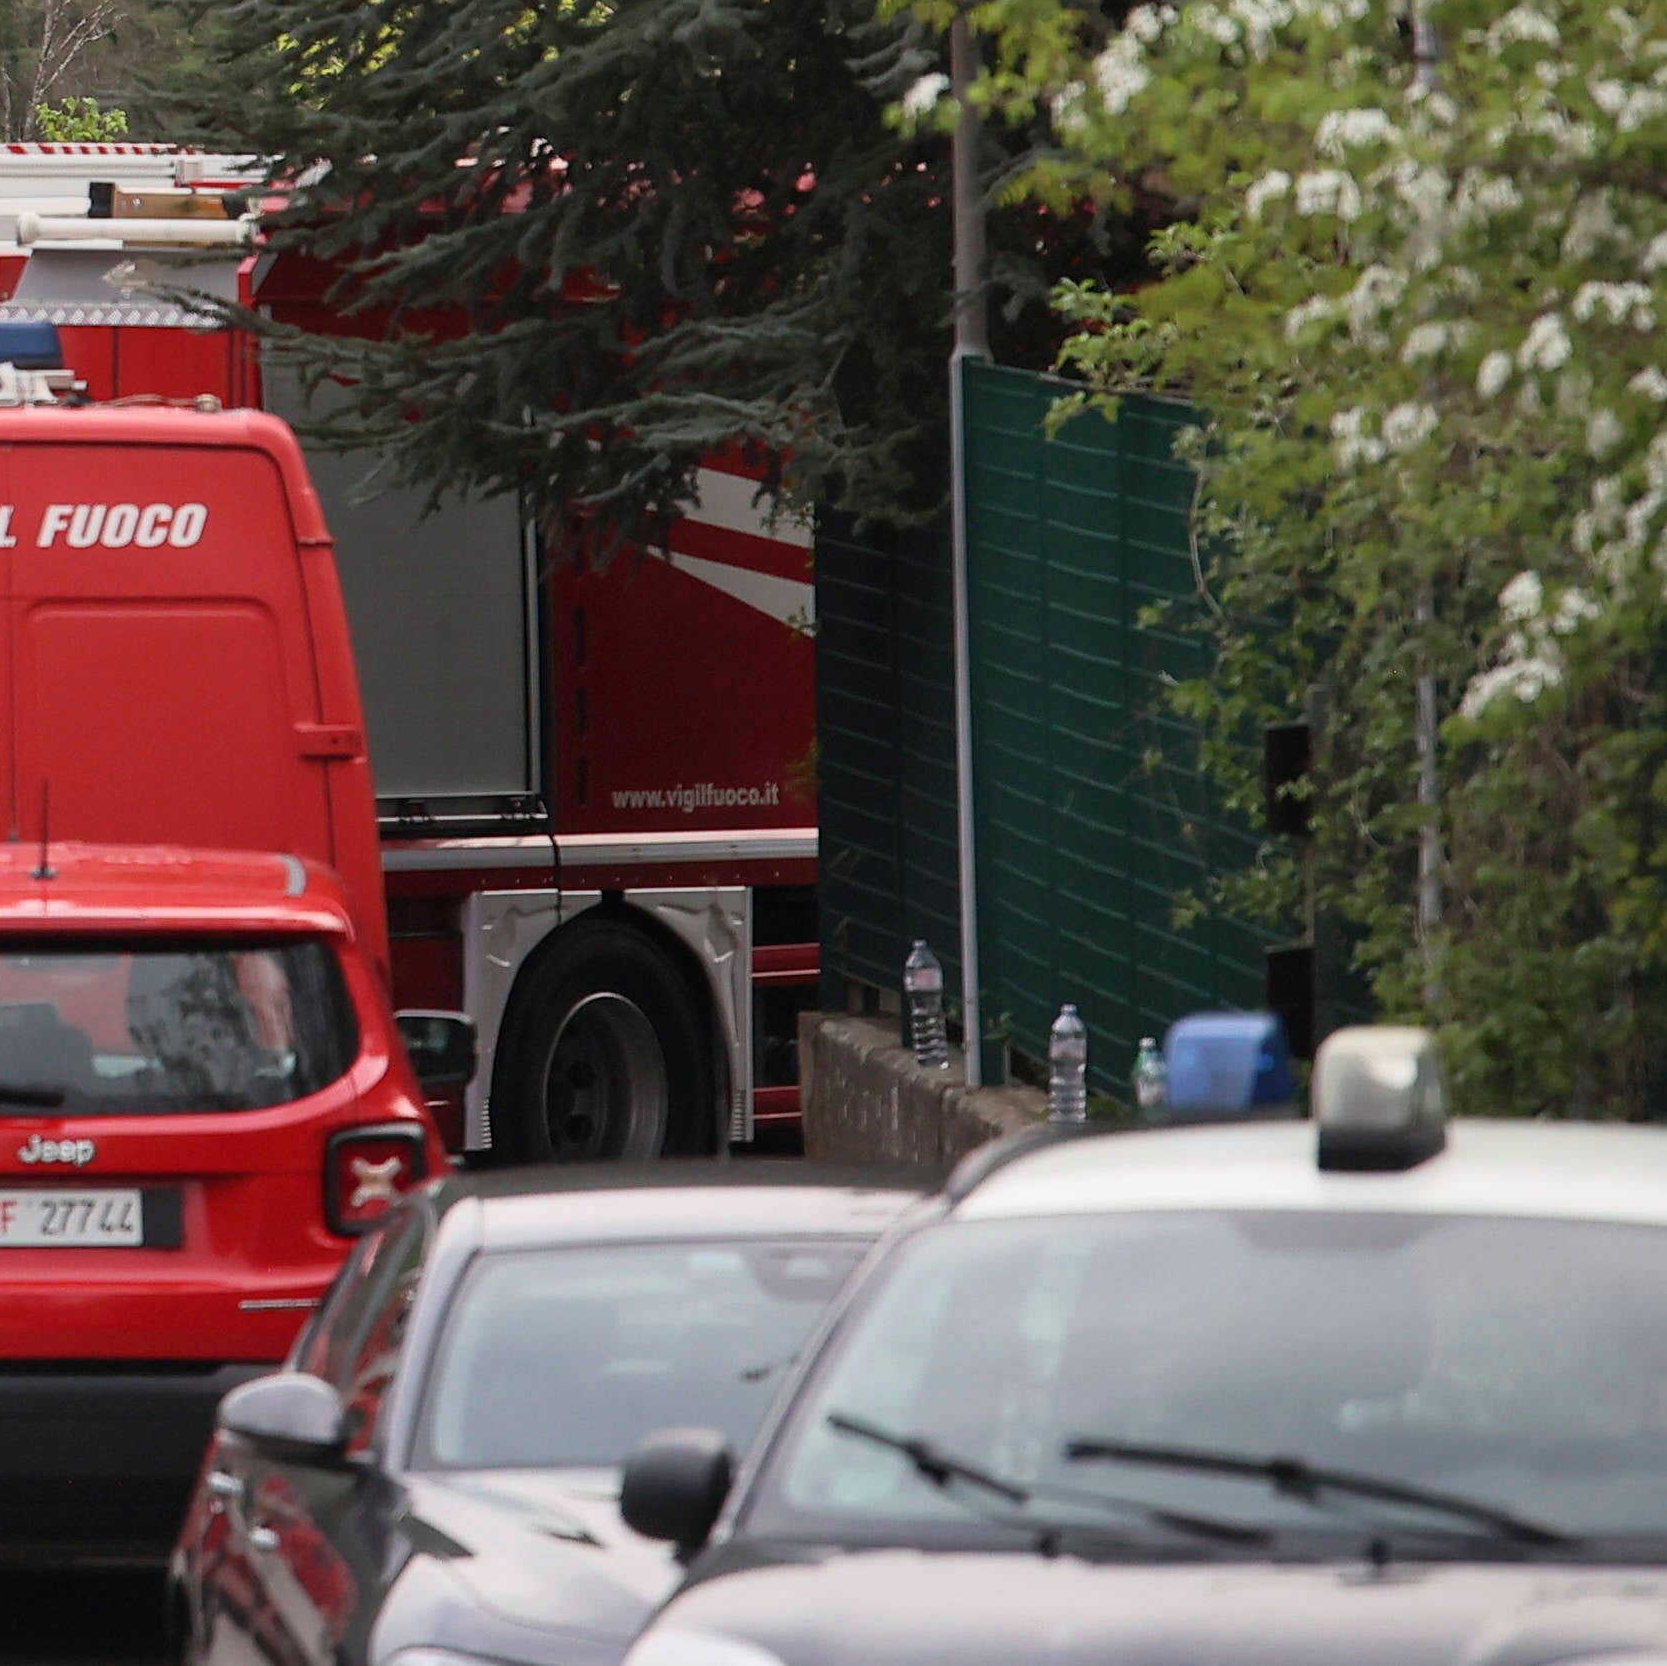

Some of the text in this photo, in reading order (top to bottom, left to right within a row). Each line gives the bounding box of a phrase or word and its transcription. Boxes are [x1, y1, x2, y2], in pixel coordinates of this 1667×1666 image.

[36, 502, 208, 548] FUOCO
[612, 782, 780, 813] www.vigilfuoco.it
[18, 1134, 95, 1168] Jeep
[40, 1198, 134, 1235] 27744
